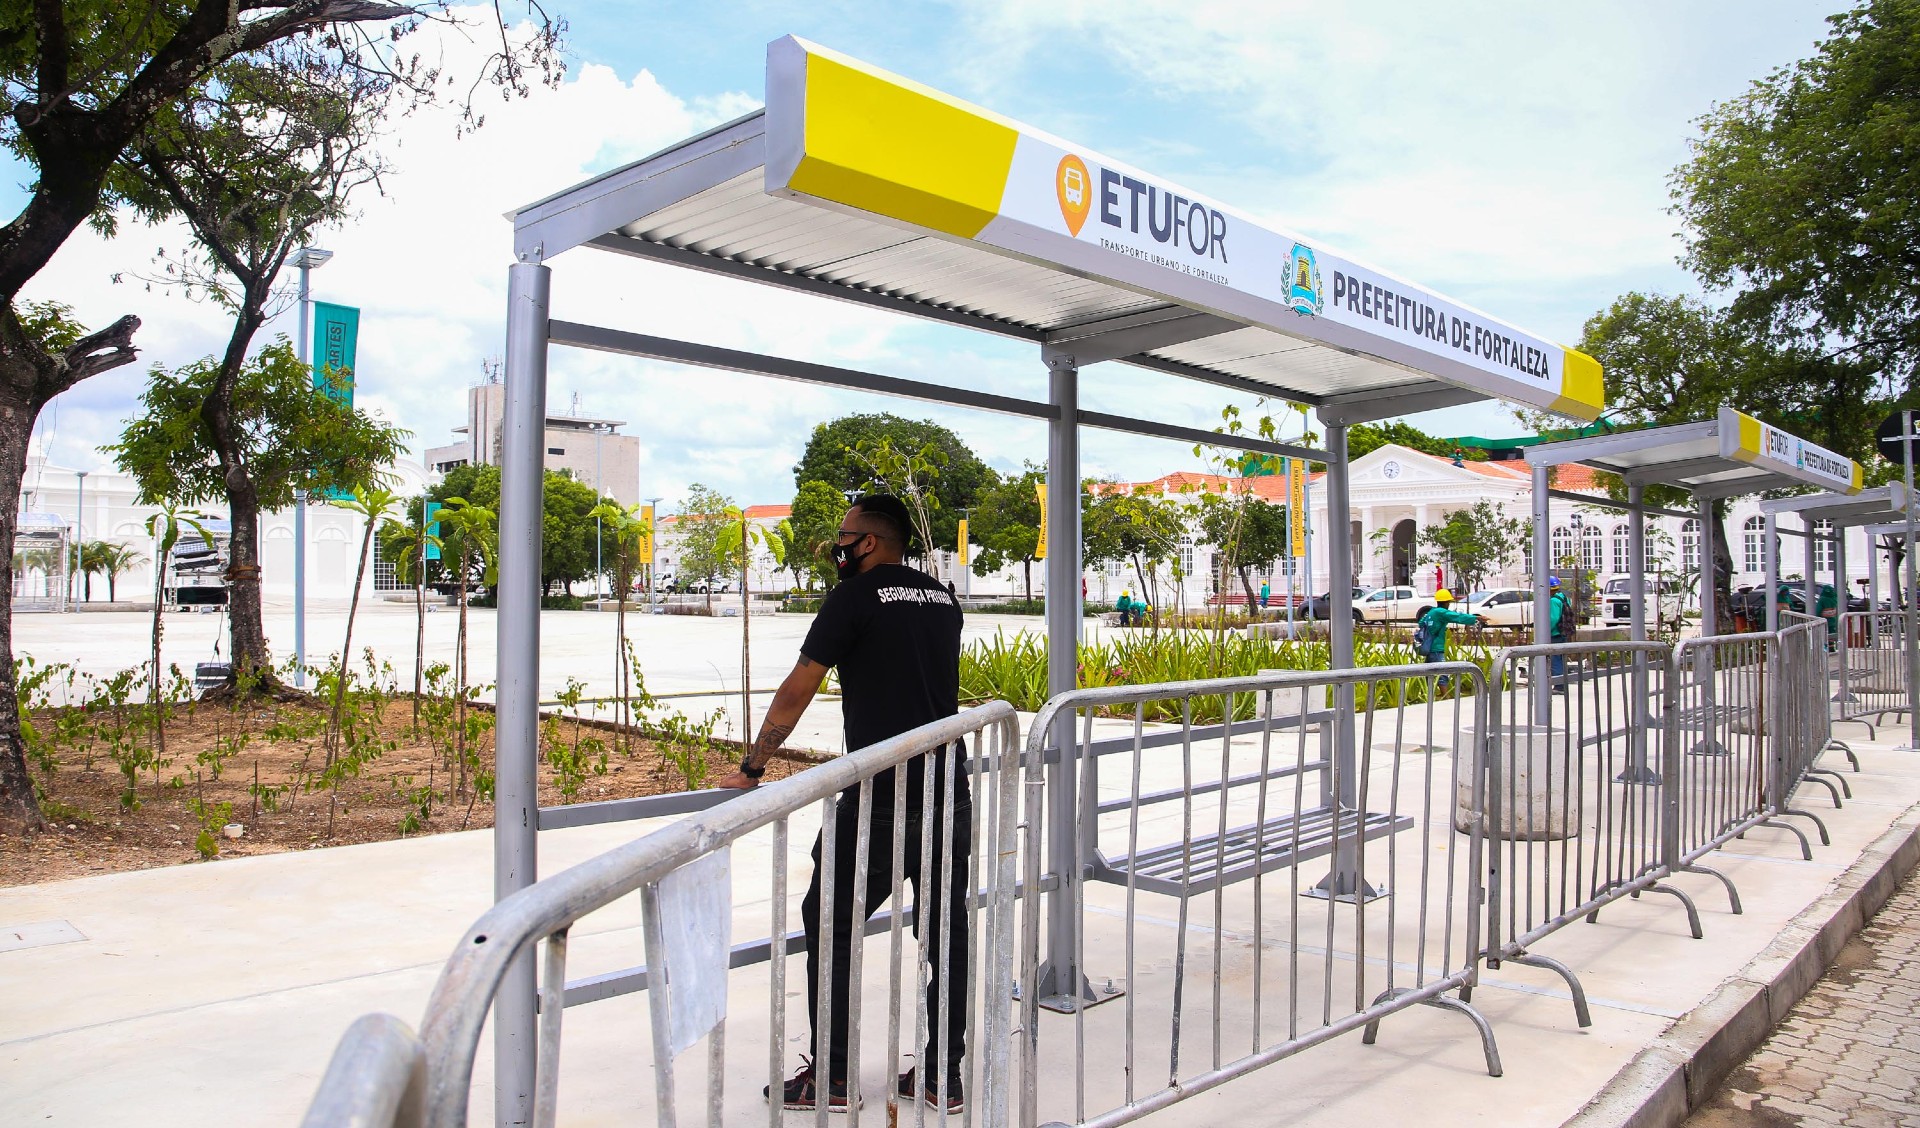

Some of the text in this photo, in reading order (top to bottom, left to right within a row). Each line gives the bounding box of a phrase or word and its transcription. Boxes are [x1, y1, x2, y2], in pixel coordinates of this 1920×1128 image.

[1100, 167, 1228, 264] ETUFOR
[1100, 237, 1229, 286] TRANSPORTE URBANO DE FORTALEZA
[1333, 270, 1550, 380] PREFEITURA DE FORTALEZA
[329, 326, 342, 367] ARTES
[1770, 430, 1788, 456] ETUFOR
[1804, 450, 1827, 472] PREFEITURA
[877, 586, 926, 606] SEGURANÇA
